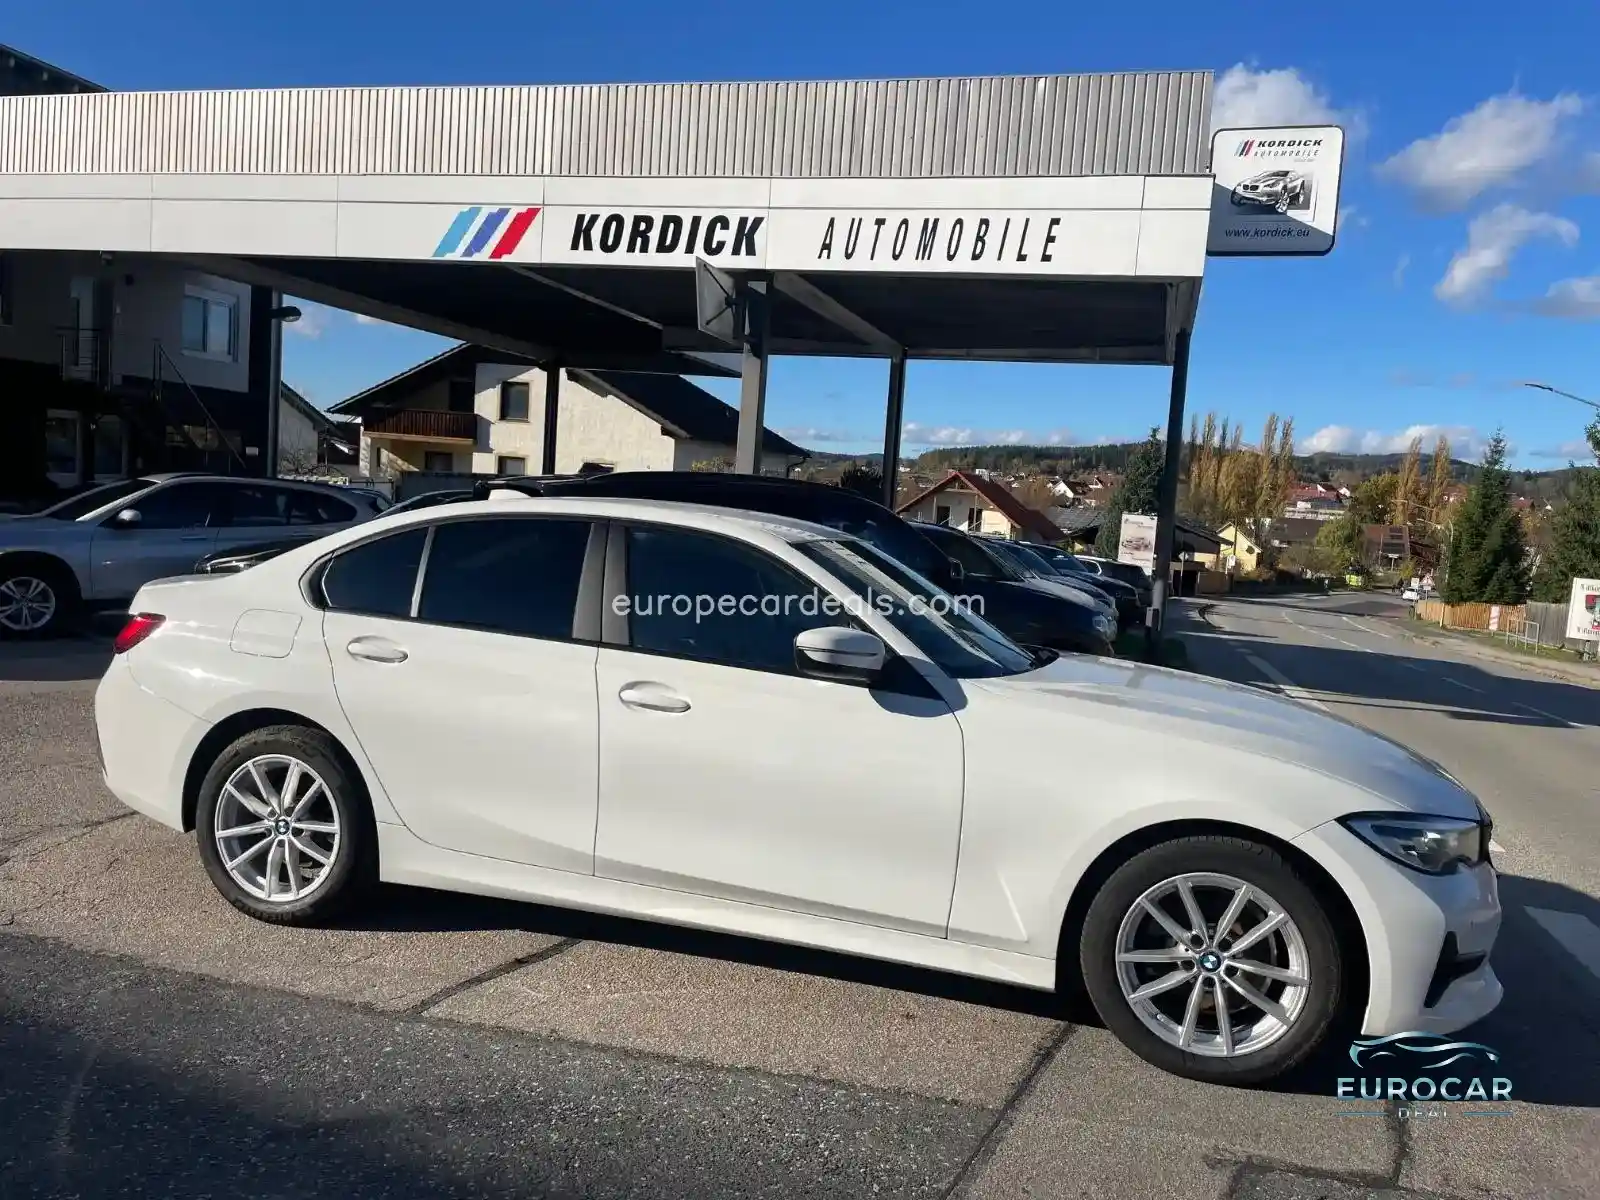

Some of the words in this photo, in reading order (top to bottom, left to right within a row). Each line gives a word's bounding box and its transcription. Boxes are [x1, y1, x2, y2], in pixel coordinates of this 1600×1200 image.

[1257, 139, 1323, 148] KORDICK
[1254, 149, 1319, 157] AUTOMOBILE
[1225, 226, 1310, 238] www.kordick.eu
[570, 213, 766, 257] KORDICK
[817, 216, 1062, 263] AUTOMOBILE
